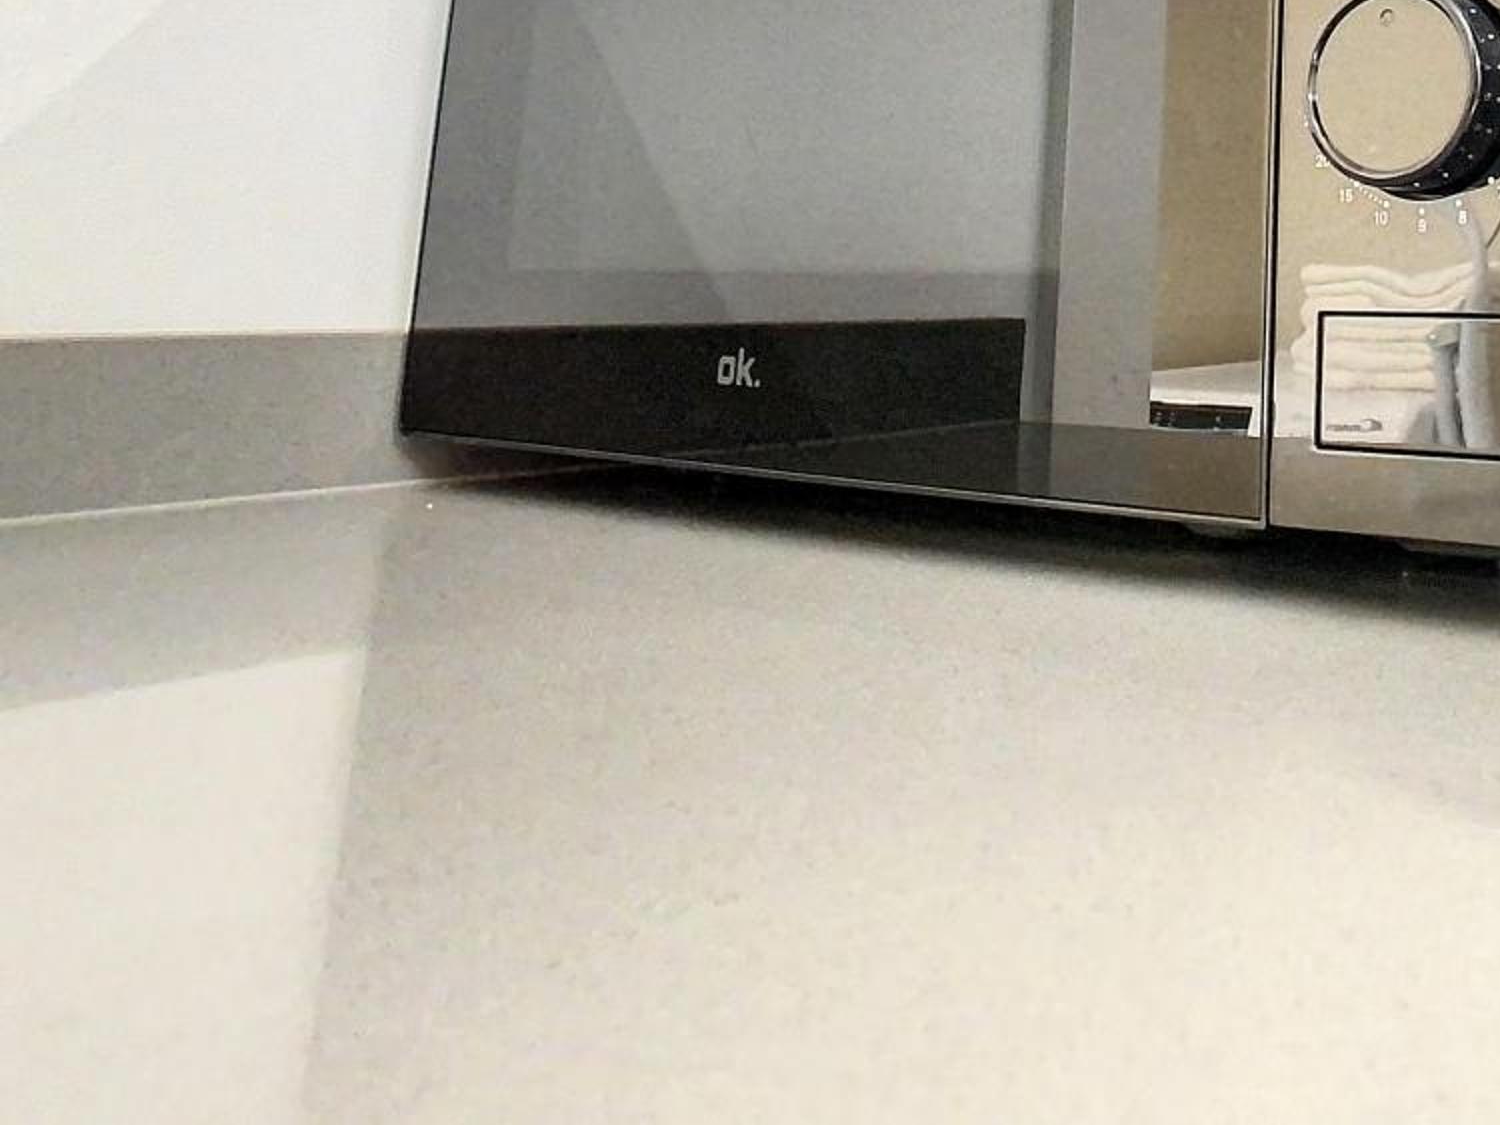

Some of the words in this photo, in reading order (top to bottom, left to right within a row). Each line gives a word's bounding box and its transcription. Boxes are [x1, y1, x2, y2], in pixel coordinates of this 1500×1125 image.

[1339, 188, 1353, 203] 15
[1374, 210, 1389, 226] 10
[717, 347, 761, 387] ok.
